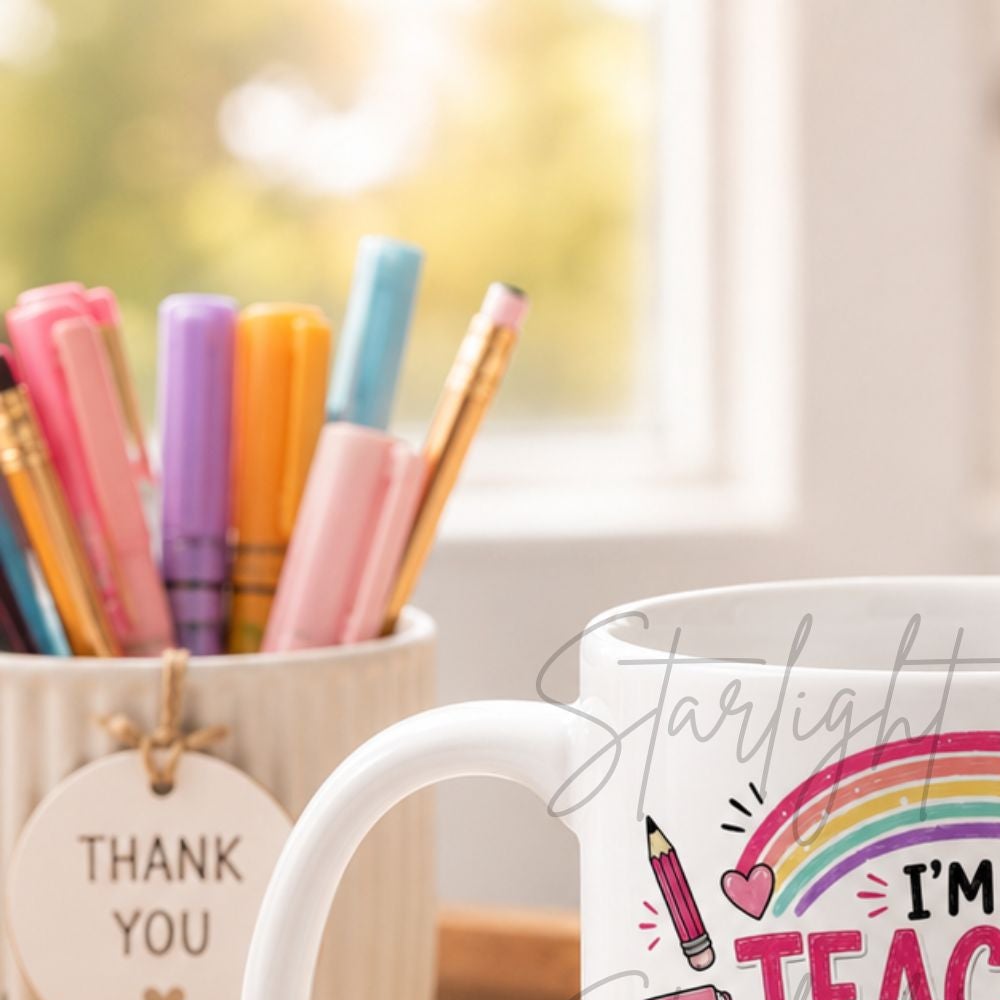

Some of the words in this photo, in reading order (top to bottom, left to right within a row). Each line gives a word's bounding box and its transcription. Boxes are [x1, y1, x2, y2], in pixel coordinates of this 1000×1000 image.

[78, 833, 244, 883] THANK
[903, 858, 995, 921] I'M
[111, 909, 211, 957] YOU
